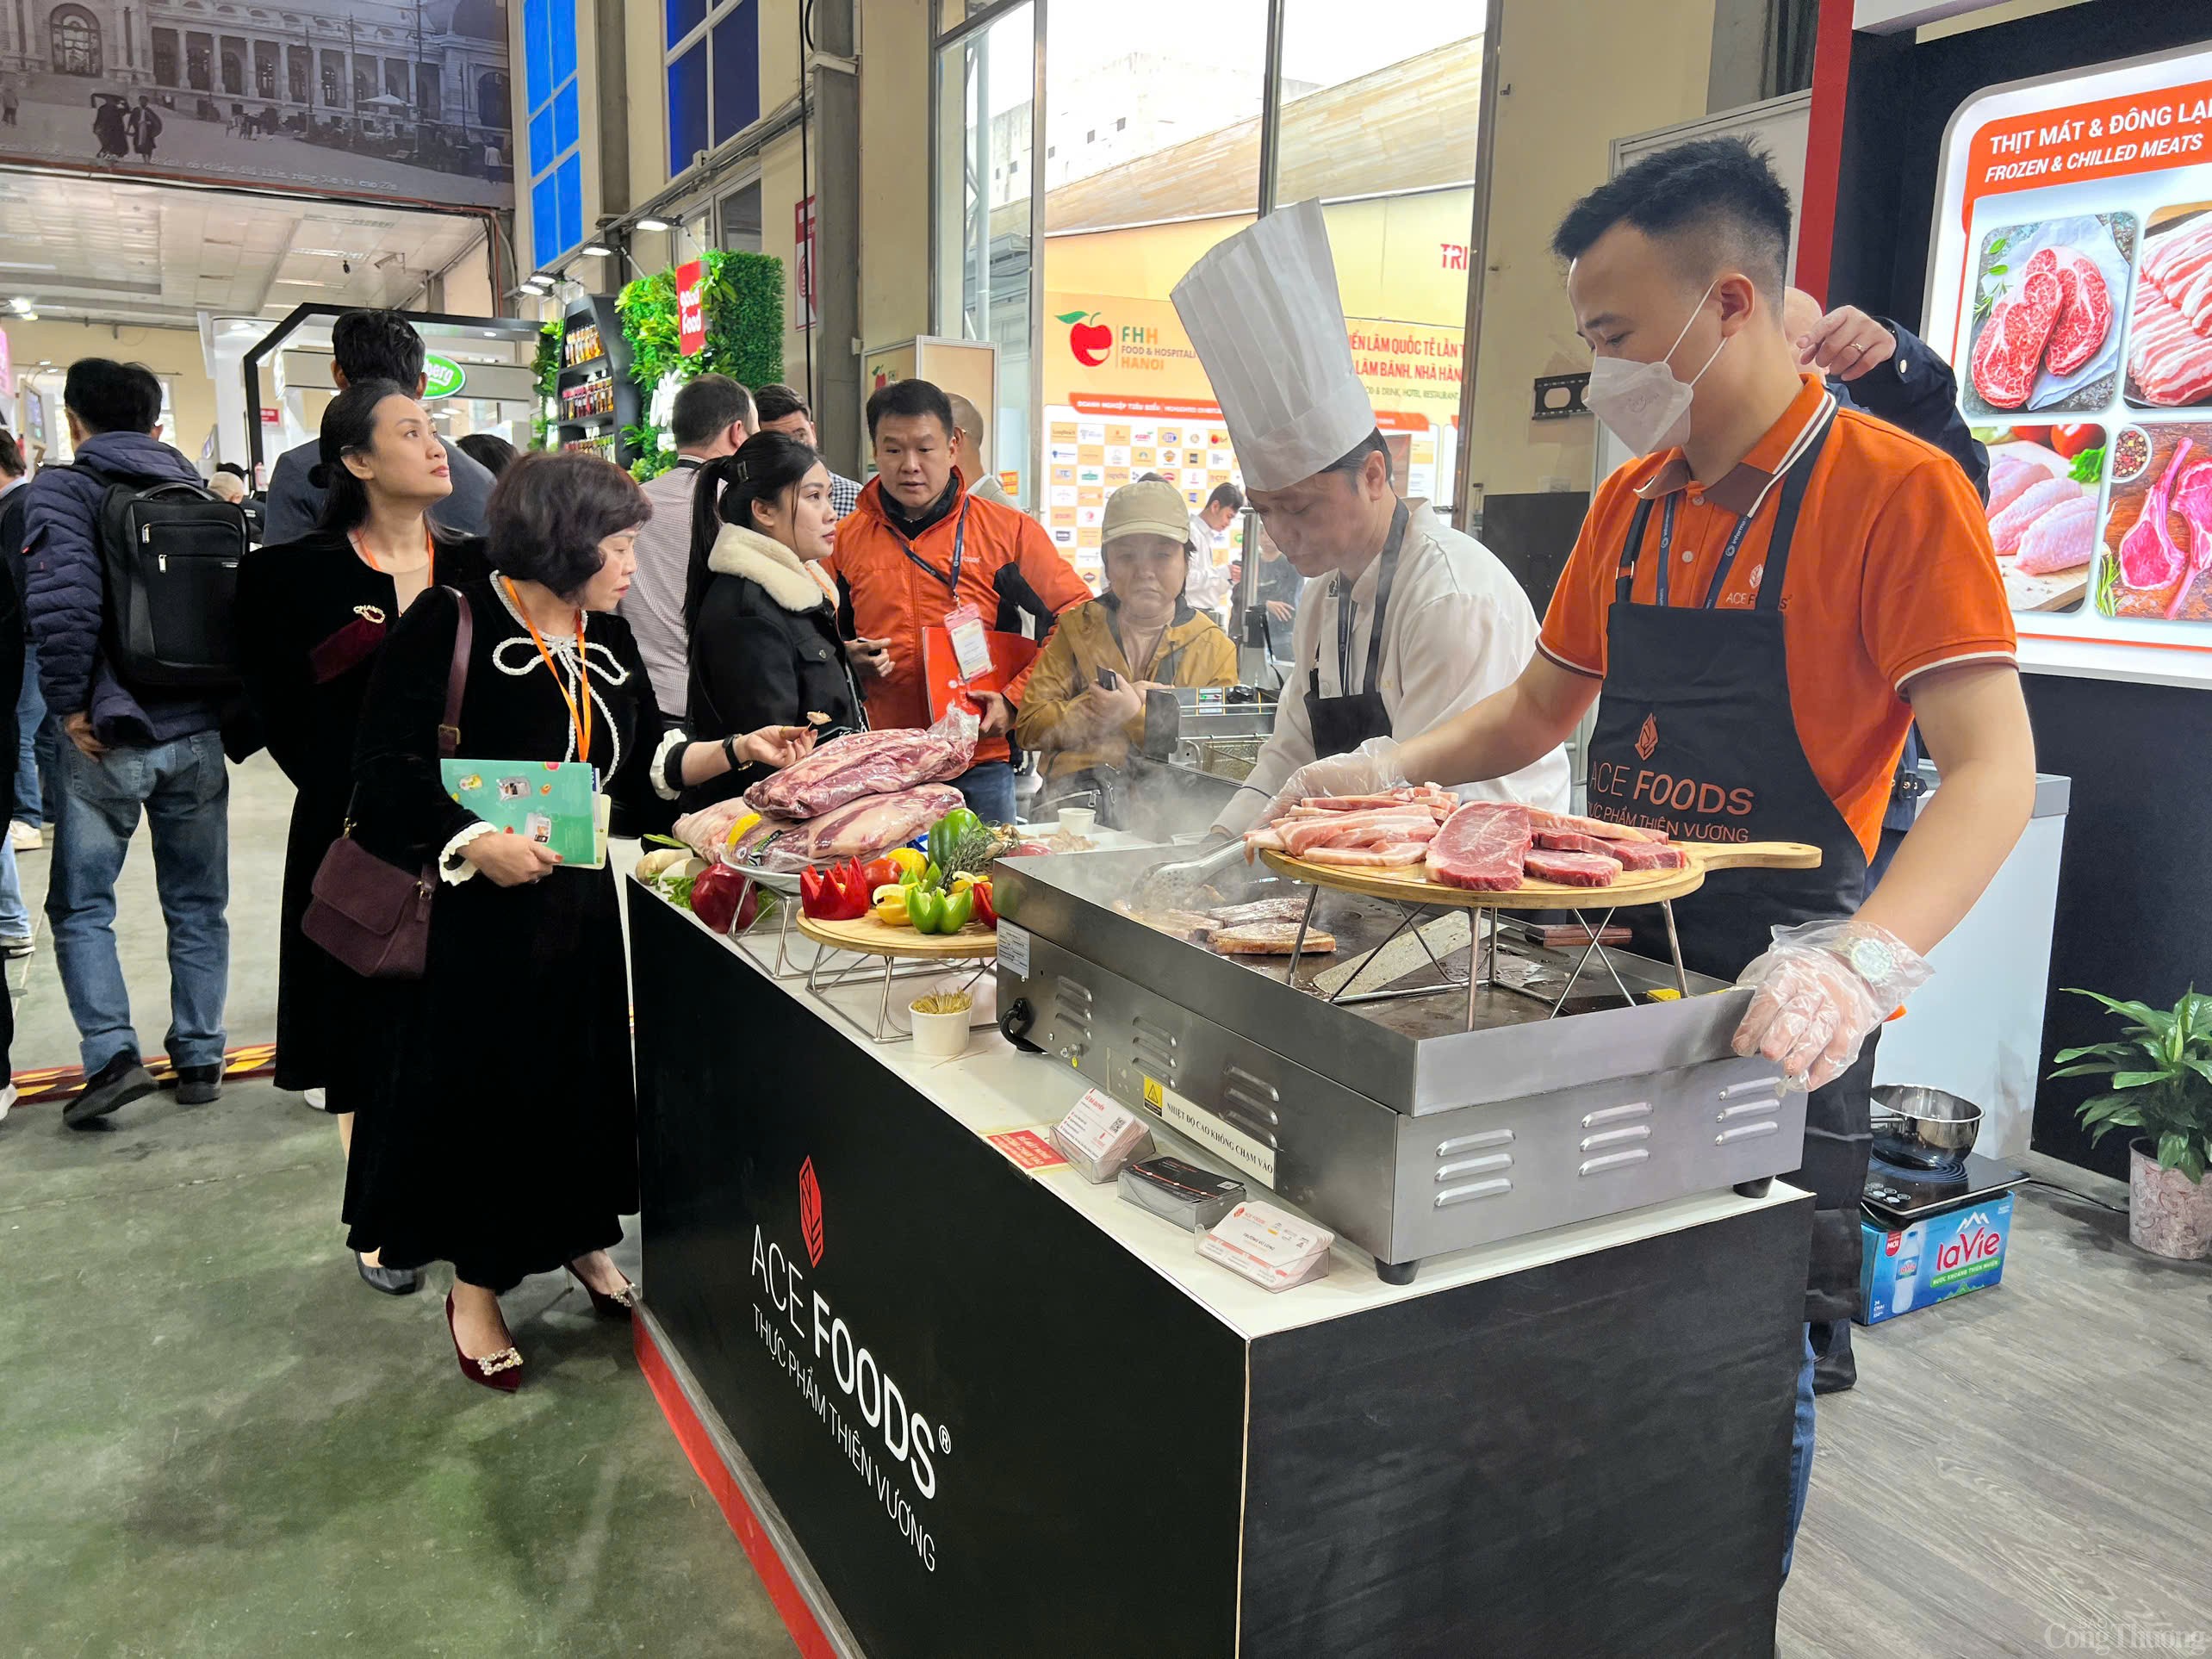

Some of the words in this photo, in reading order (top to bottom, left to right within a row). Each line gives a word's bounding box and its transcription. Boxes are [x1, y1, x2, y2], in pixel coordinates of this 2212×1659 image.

[1990, 131, 2035, 155] THỊT
[2039, 120, 2085, 147] MÁT
[2088, 118, 2103, 138] &
[2109, 106, 2172, 134] ĐÔNG
[2178, 98, 2212, 125] LẠ
[1985, 158, 2048, 183] FROZEN
[2051, 156, 2062, 172] &
[2066, 144, 2138, 171] CHILLED
[2140, 134, 2203, 159] MEATS
[1440, 243, 1469, 270] TRI
[1122, 326, 1159, 345] FHH
[1122, 345, 1145, 355] FOOD
[1392, 334, 1421, 356] QUỐC
[422, 358, 454, 387] berg
[1122, 357, 1164, 370] HANOI
[1438, 364, 1463, 382] HÀN
[1725, 592, 1748, 604] ACE
[1589, 760, 1631, 797] ACE
[1632, 769, 1755, 816] FOODS
[1604, 805, 1637, 827] PHẨM
[1683, 822, 1749, 843] VƯƠNG
[1167, 1103, 1185, 1121] NHIỆT
[1186, 1115, 1195, 1128] ĐỘ
[1196, 1122, 1210, 1136] CAO
[1211, 1129, 1235, 1152] KHÔNG
[1235, 1145, 1257, 1164] CHẠM
[1257, 1158, 1273, 1174] VÀO
[1936, 1227, 2001, 1271] laVie
[752, 1224, 805, 1339] ACE
[753, 1302, 786, 1368] THỰC
[788, 1349, 826, 1424] PHẨM
[829, 1402, 872, 1487] THIÊN
[875, 1464, 935, 1572] VƯƠNG
